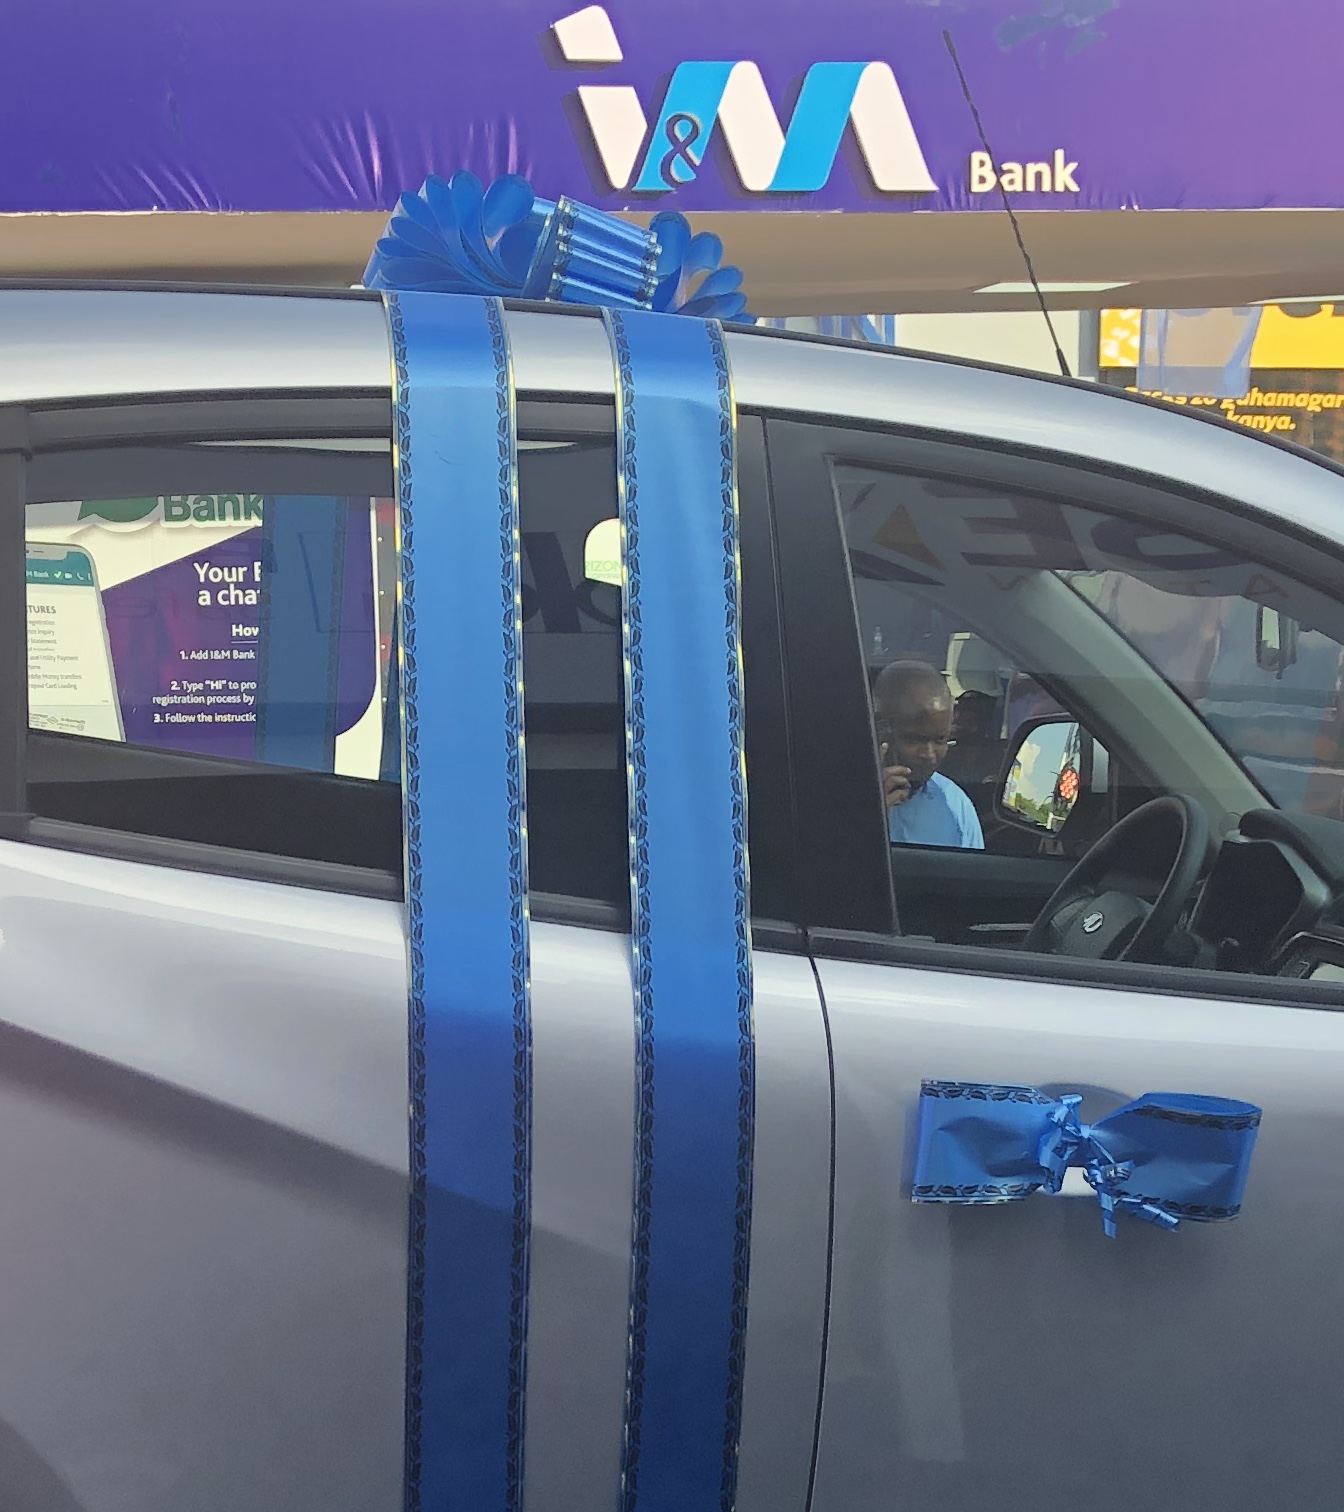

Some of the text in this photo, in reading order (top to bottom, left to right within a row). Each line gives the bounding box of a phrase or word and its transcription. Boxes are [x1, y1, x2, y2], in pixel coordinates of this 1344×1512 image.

[970, 148, 1080, 193] Bank
[193, 562, 248, 583] Your
[197, 589, 212, 606] a
[190, 650, 209, 660] Add
[233, 650, 255, 660] Bank
[182, 681, 204, 693] Type
[228, 681, 239, 690] to
[152, 693, 255, 706] registration process by
[165, 713, 196, 723] Follow
[197, 713, 213, 723] the
